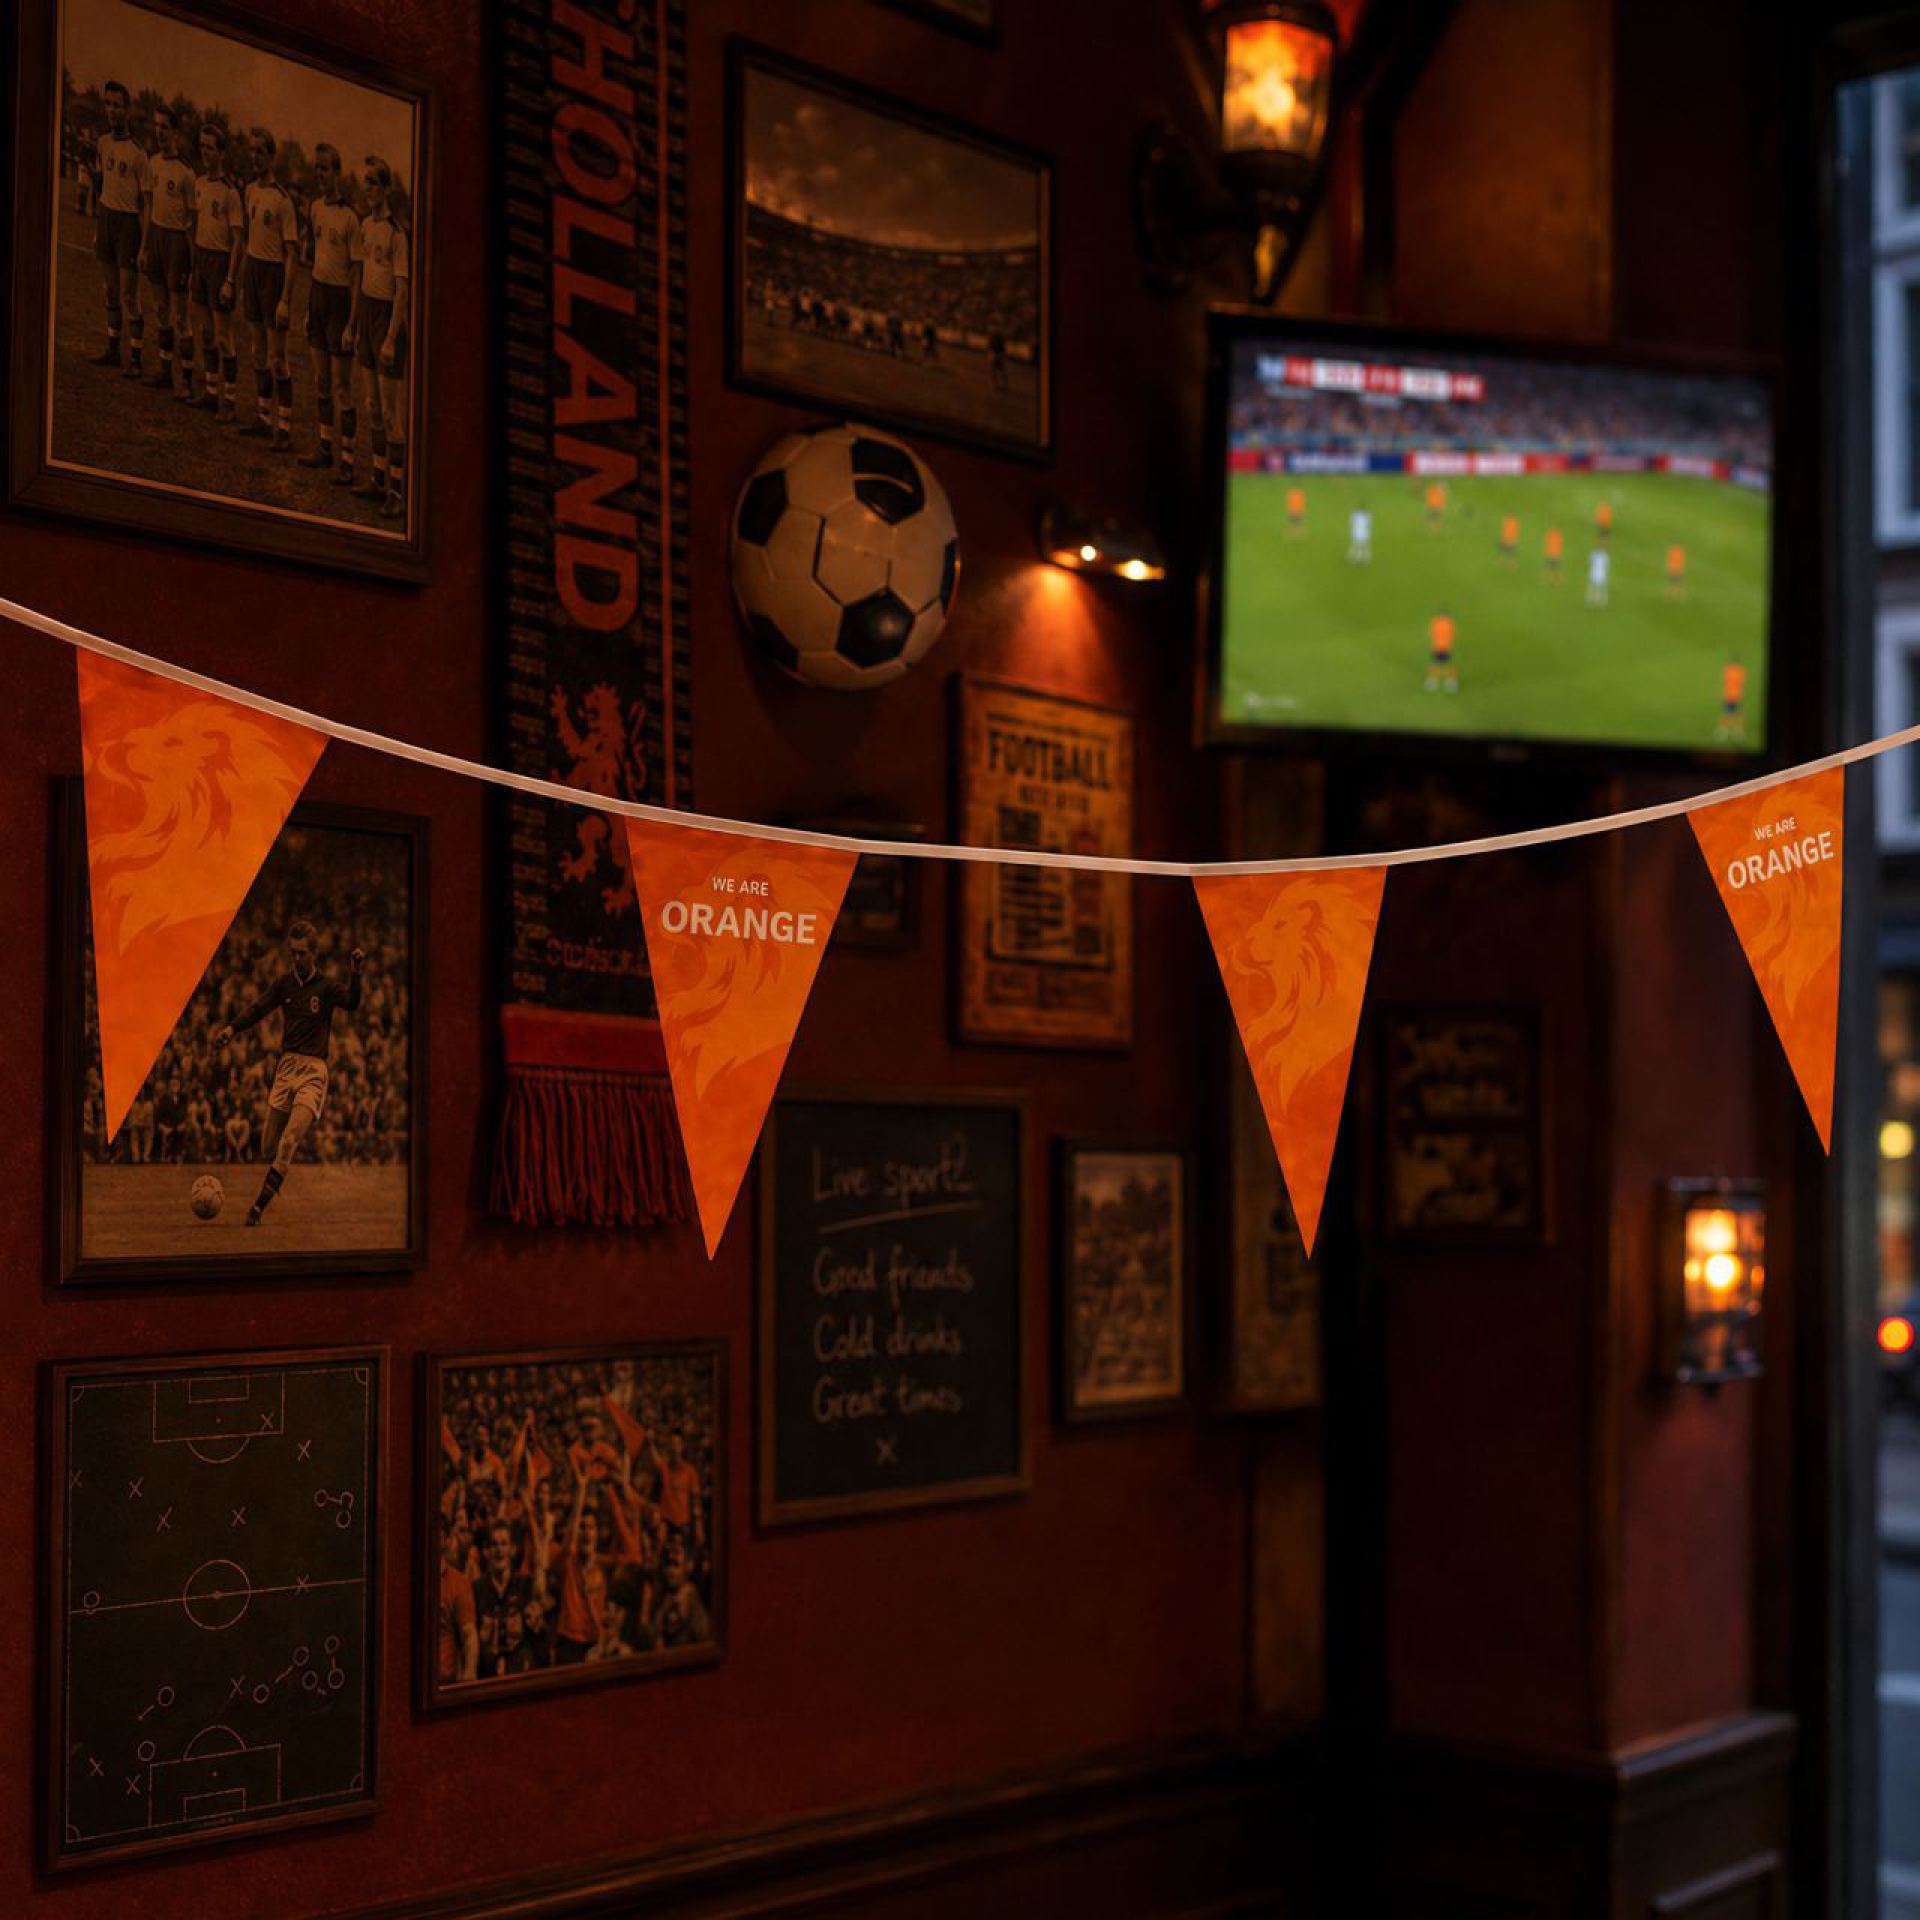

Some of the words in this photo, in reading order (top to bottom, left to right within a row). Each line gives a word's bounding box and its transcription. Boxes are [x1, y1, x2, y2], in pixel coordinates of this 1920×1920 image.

[987, 728, 1110, 792] FOOTBALL
[1754, 824, 1774, 840] WE
[1775, 816, 1797, 835] ARE
[1727, 831, 1835, 889] ORANGE
[712, 876, 735, 893] WE
[739, 880, 769, 896] ARE
[662, 900, 817, 945] ORANGE
[814, 1312, 877, 1363] Cold
